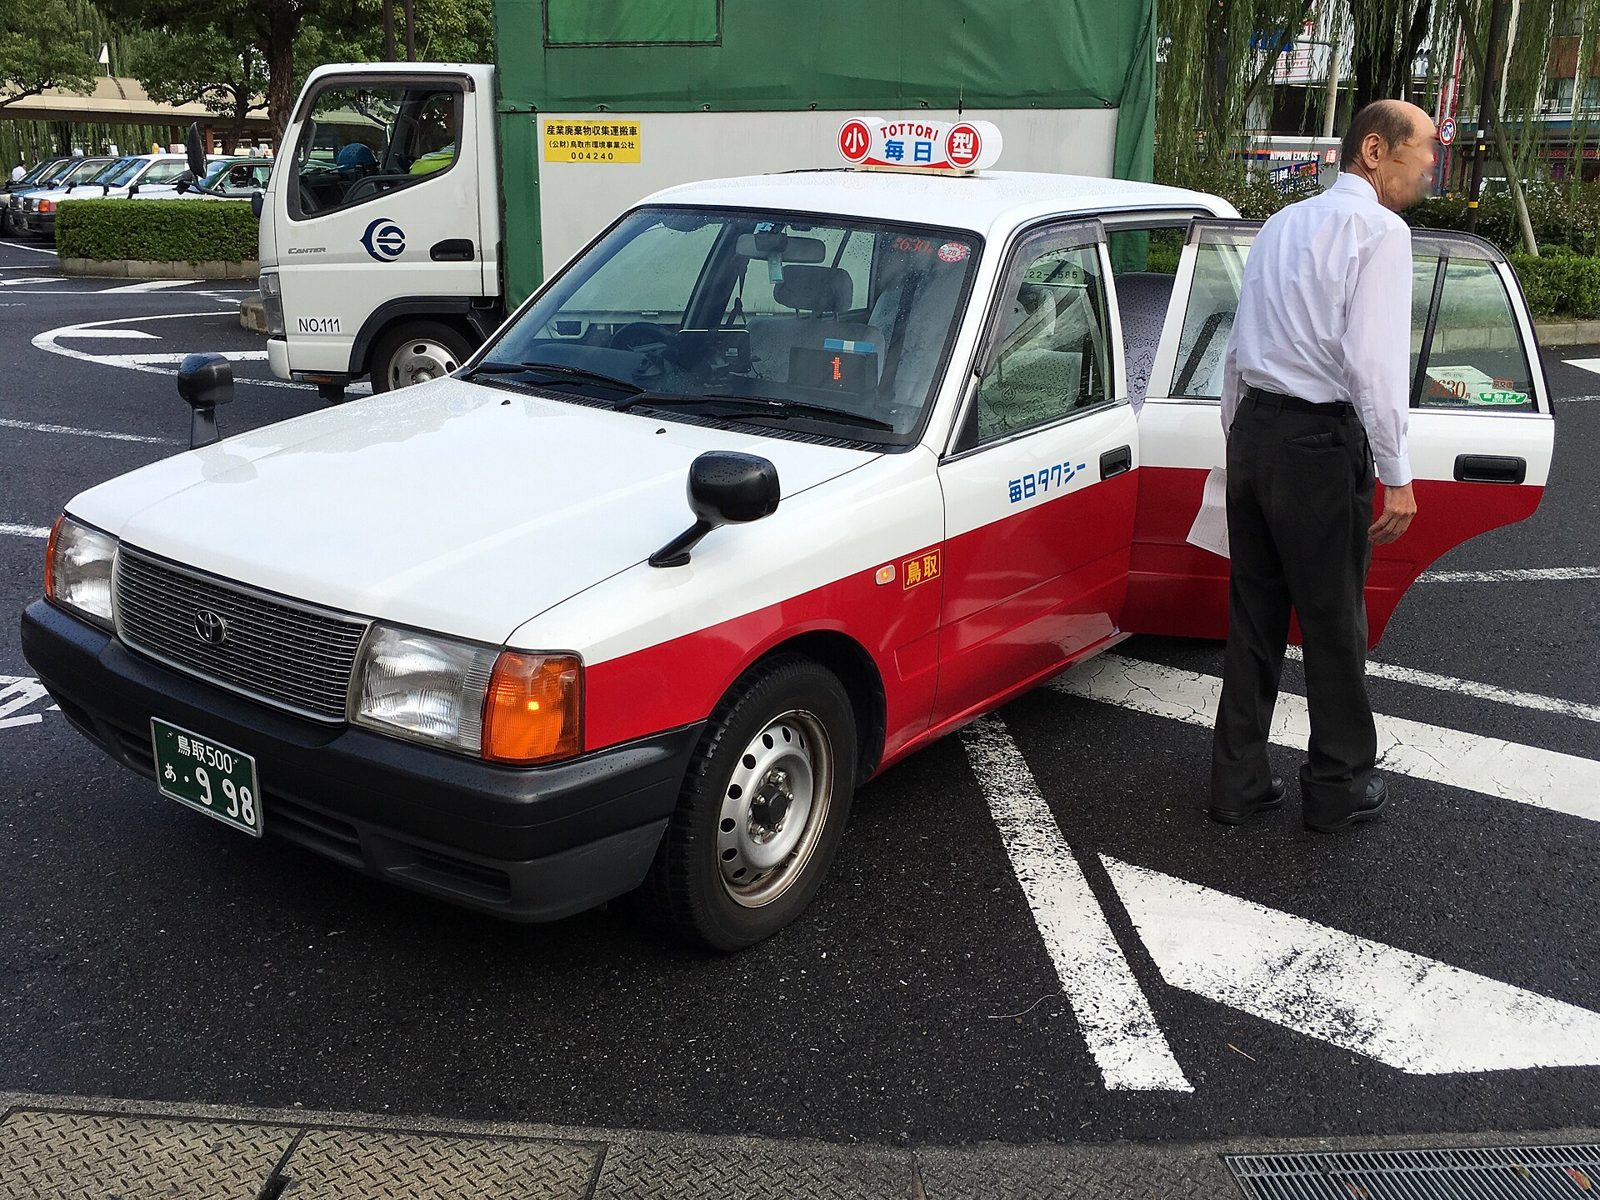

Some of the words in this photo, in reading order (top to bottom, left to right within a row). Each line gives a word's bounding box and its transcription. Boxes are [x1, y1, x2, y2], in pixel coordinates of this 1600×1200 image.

[546, 125, 638, 136] 産業廃棄物収集運搬車
[844, 127, 865, 153] 小
[880, 123, 940, 141] TOTTORI
[571, 152, 614, 160] 004240
[884, 139, 932, 163] 毎日
[951, 132, 974, 159] 型
[1269, 151, 1292, 161] NIPPON
[1293, 151, 1319, 161] EXPRESS
[298, 318, 340, 333] NO.111
[1008, 461, 1086, 503] 毎日タクシー
[906, 555, 938, 586] 鳥取
